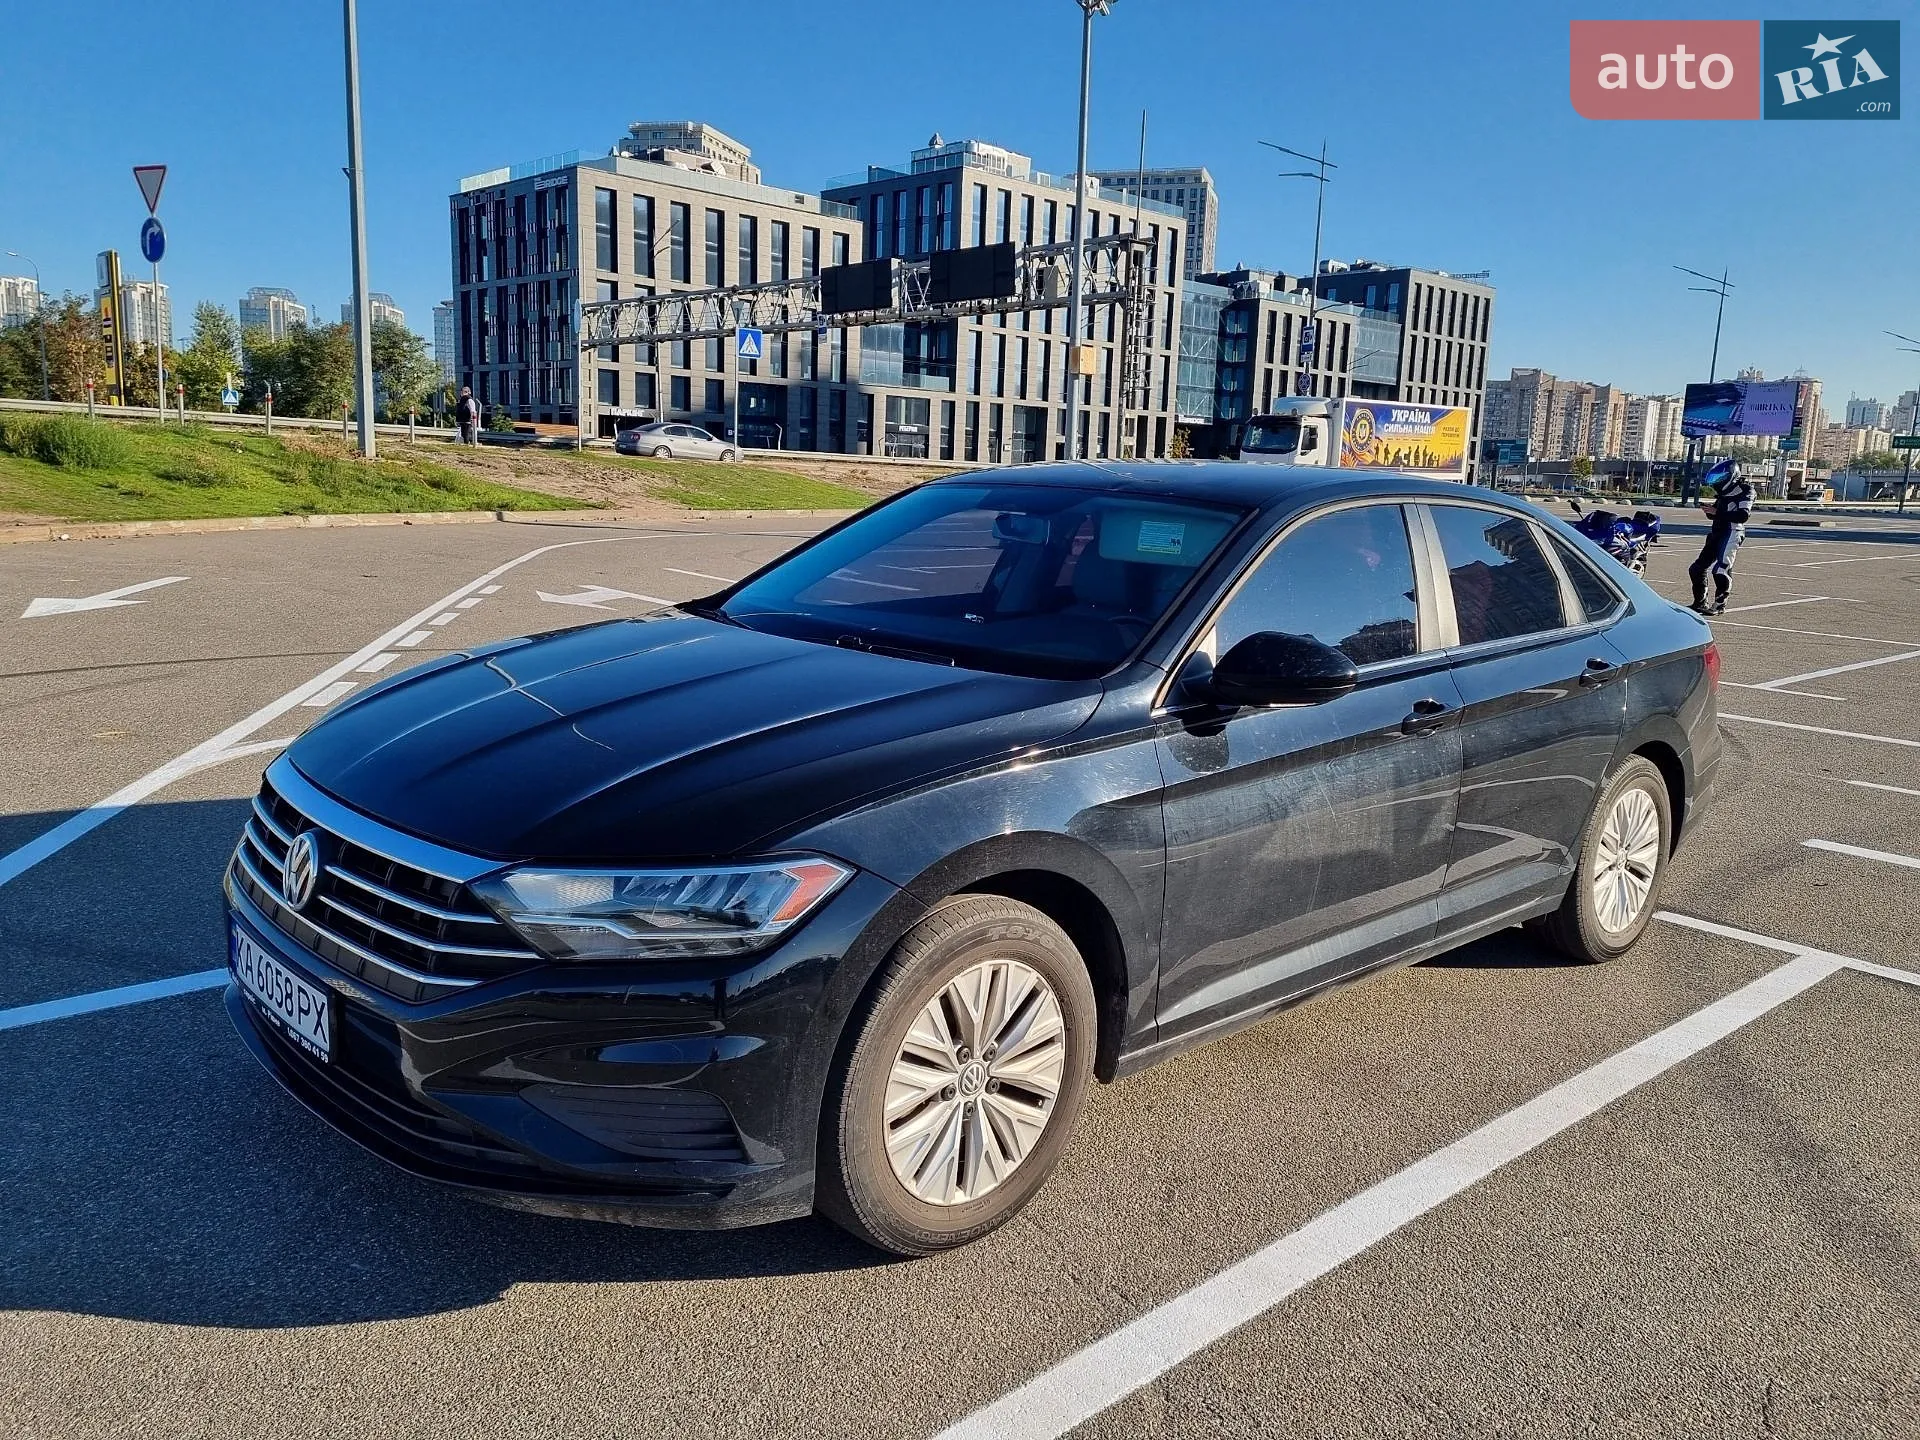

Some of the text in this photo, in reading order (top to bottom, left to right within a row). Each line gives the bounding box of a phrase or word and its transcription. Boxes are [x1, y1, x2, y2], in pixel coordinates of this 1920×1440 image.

[1391, 408, 1431, 424] УКРАЇНА
[1383, 423, 1413, 434] СИЛЬНА
[236, 930, 328, 1044] KA 6058 PX
